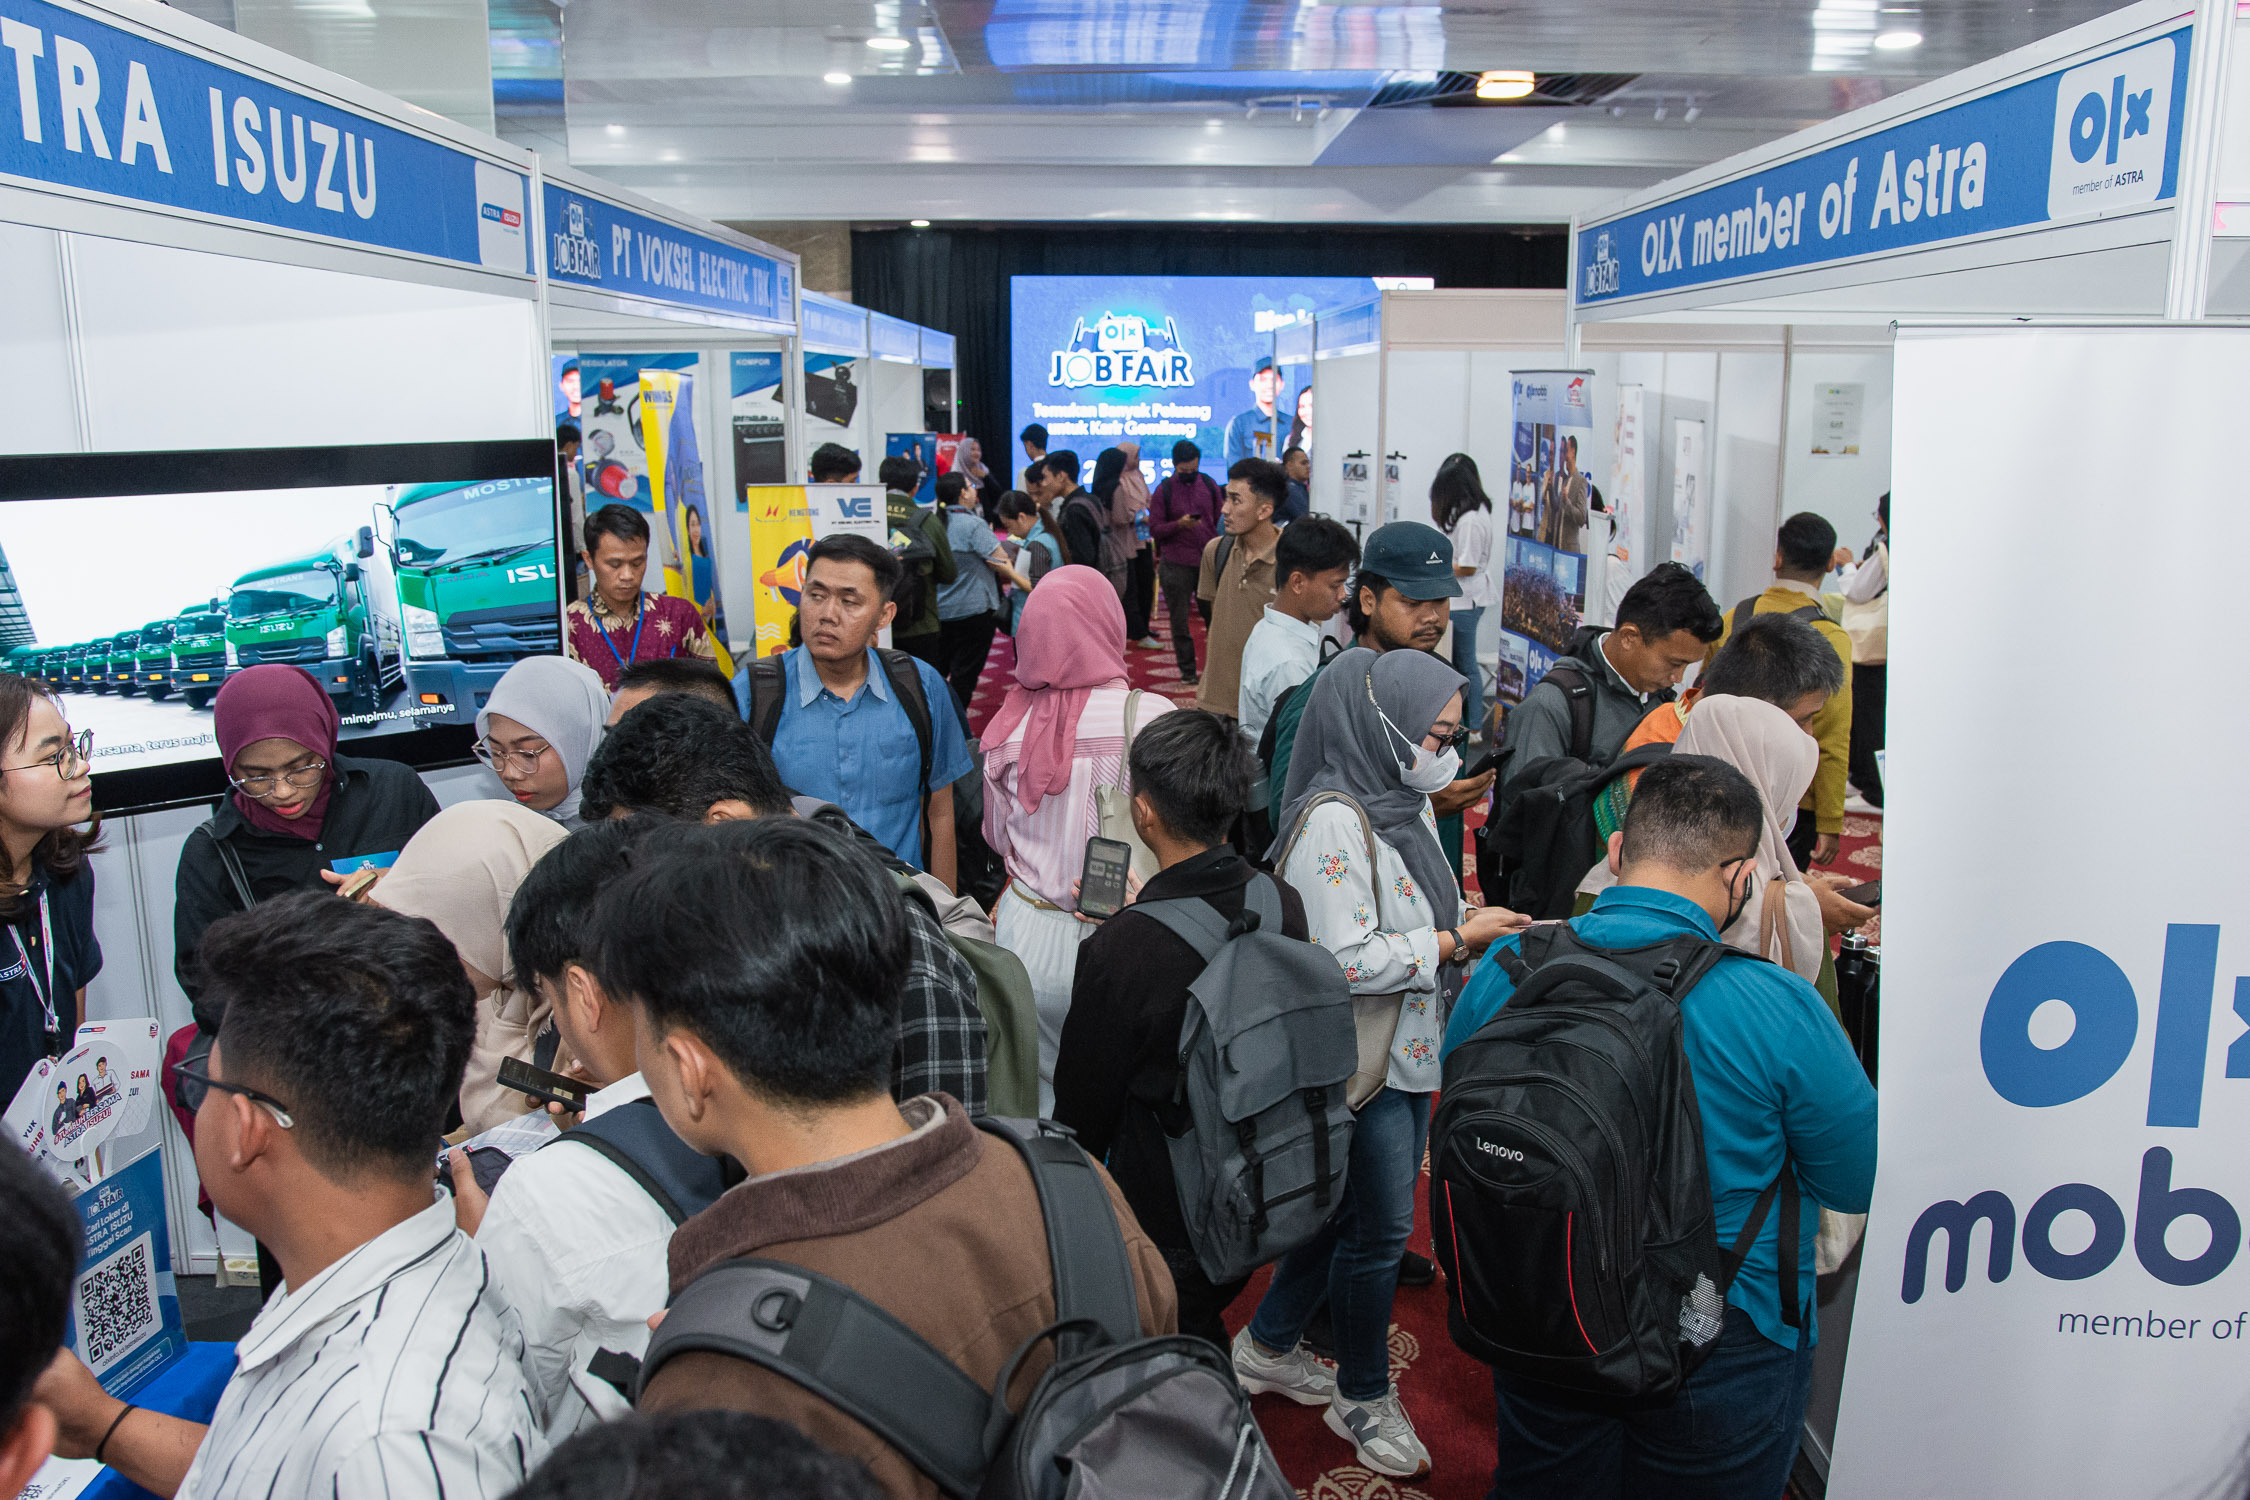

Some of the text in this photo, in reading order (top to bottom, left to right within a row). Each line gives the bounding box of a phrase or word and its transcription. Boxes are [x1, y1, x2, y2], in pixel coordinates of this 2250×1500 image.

[2069, 74, 2154, 166] olx
[208, 86, 378, 220] ISUZU
[2072, 168, 2145, 196] member of ASTRA
[482, 205, 501, 219] ASTRA
[1641, 140, 1989, 278] OLX member of Astra
[554, 232, 576, 274] JOB
[611, 223, 632, 279] PT
[637, 231, 696, 293] VOKSEL
[699, 250, 750, 304] ELECTRIC
[581, 359, 628, 368] REGULATOR
[736, 357, 770, 367] KOMPOR
[1053, 353, 1190, 384] JOB FAIR
[463, 477, 551, 501] MOSTR
[259, 621, 296, 634] ISUZU
[341, 703, 456, 726] mimpimu, selamanya
[145, 738, 181, 751] terus
[182, 733, 214, 747] maju
[1980, 922, 2250, 1140] ol
[85, 1091, 123, 1120] BERSAMA
[22, 1119, 38, 1140] YUK
[63, 1106, 112, 1149] ASTRA ISUZU!
[1476, 1136, 1524, 1163] Lenovo
[85, 1201, 130, 1236] Cari Loker di
[110, 1210, 133, 1232] ISUZU
[1901, 1145, 2250, 1305] mob
[87, 1224, 133, 1259] Tinggal Scan
[2058, 1309, 2249, 1341] member of
